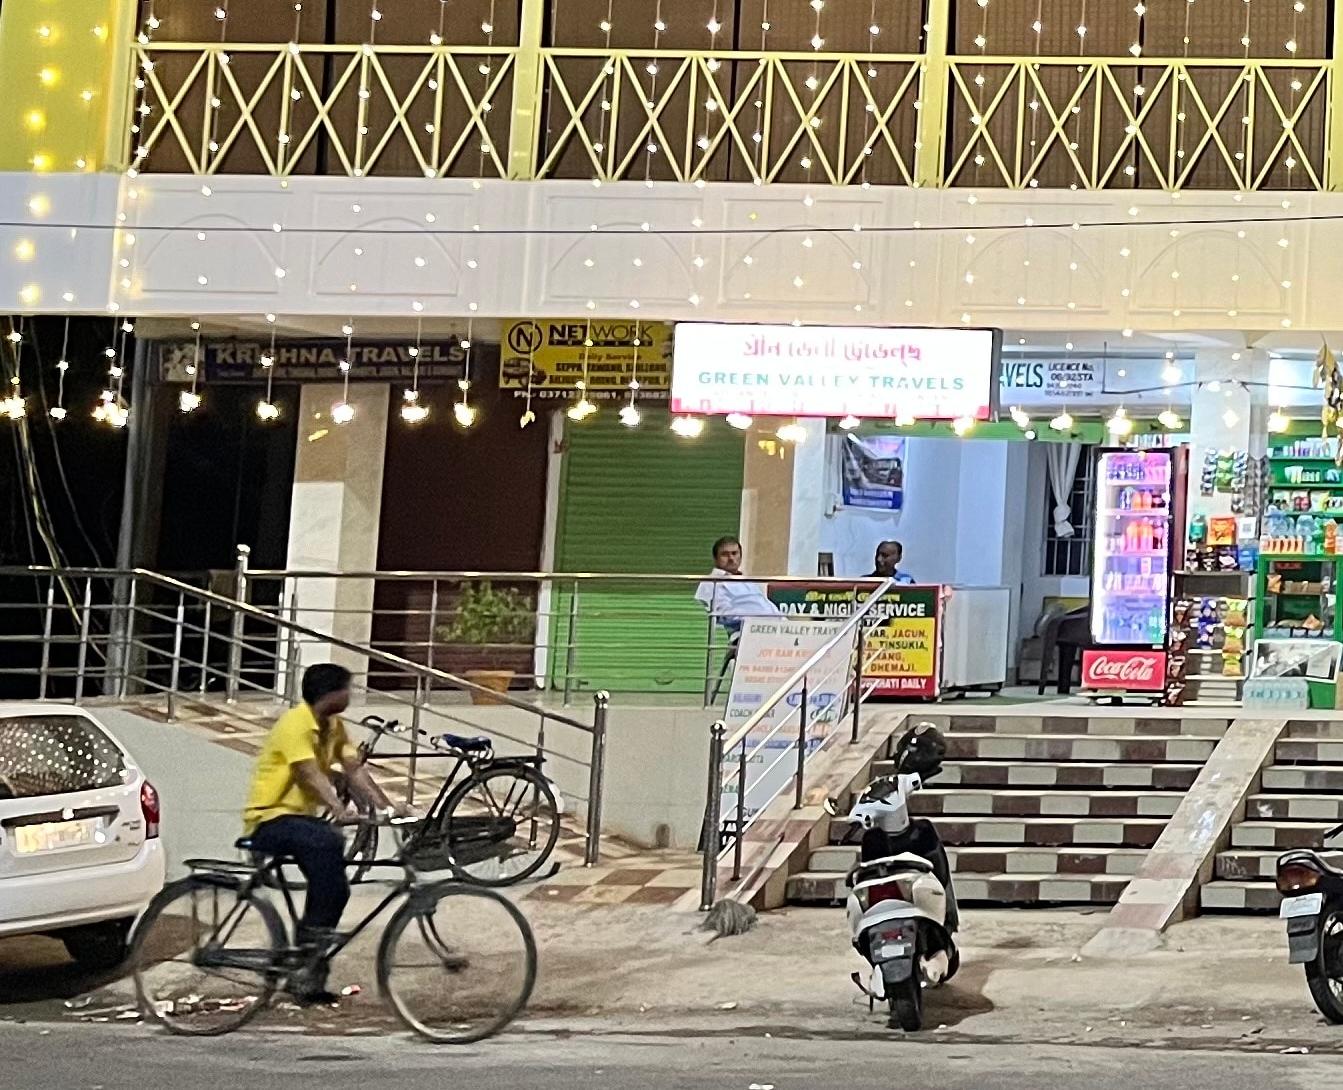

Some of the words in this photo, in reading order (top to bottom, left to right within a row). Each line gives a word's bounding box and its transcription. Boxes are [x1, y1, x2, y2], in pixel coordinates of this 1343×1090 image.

[549, 324, 653, 340] NETWORK
[216, 347, 336, 364] KRIHNA
[346, 346, 465, 362] TRAVELS
[698, 371, 769, 386] GREEN
[779, 373, 859, 388] VALLEY
[871, 375, 965, 390] TRAVELS
[779, 602, 807, 615] DAY
[810, 602, 819, 615] &
[868, 603, 926, 617] SERVICE
